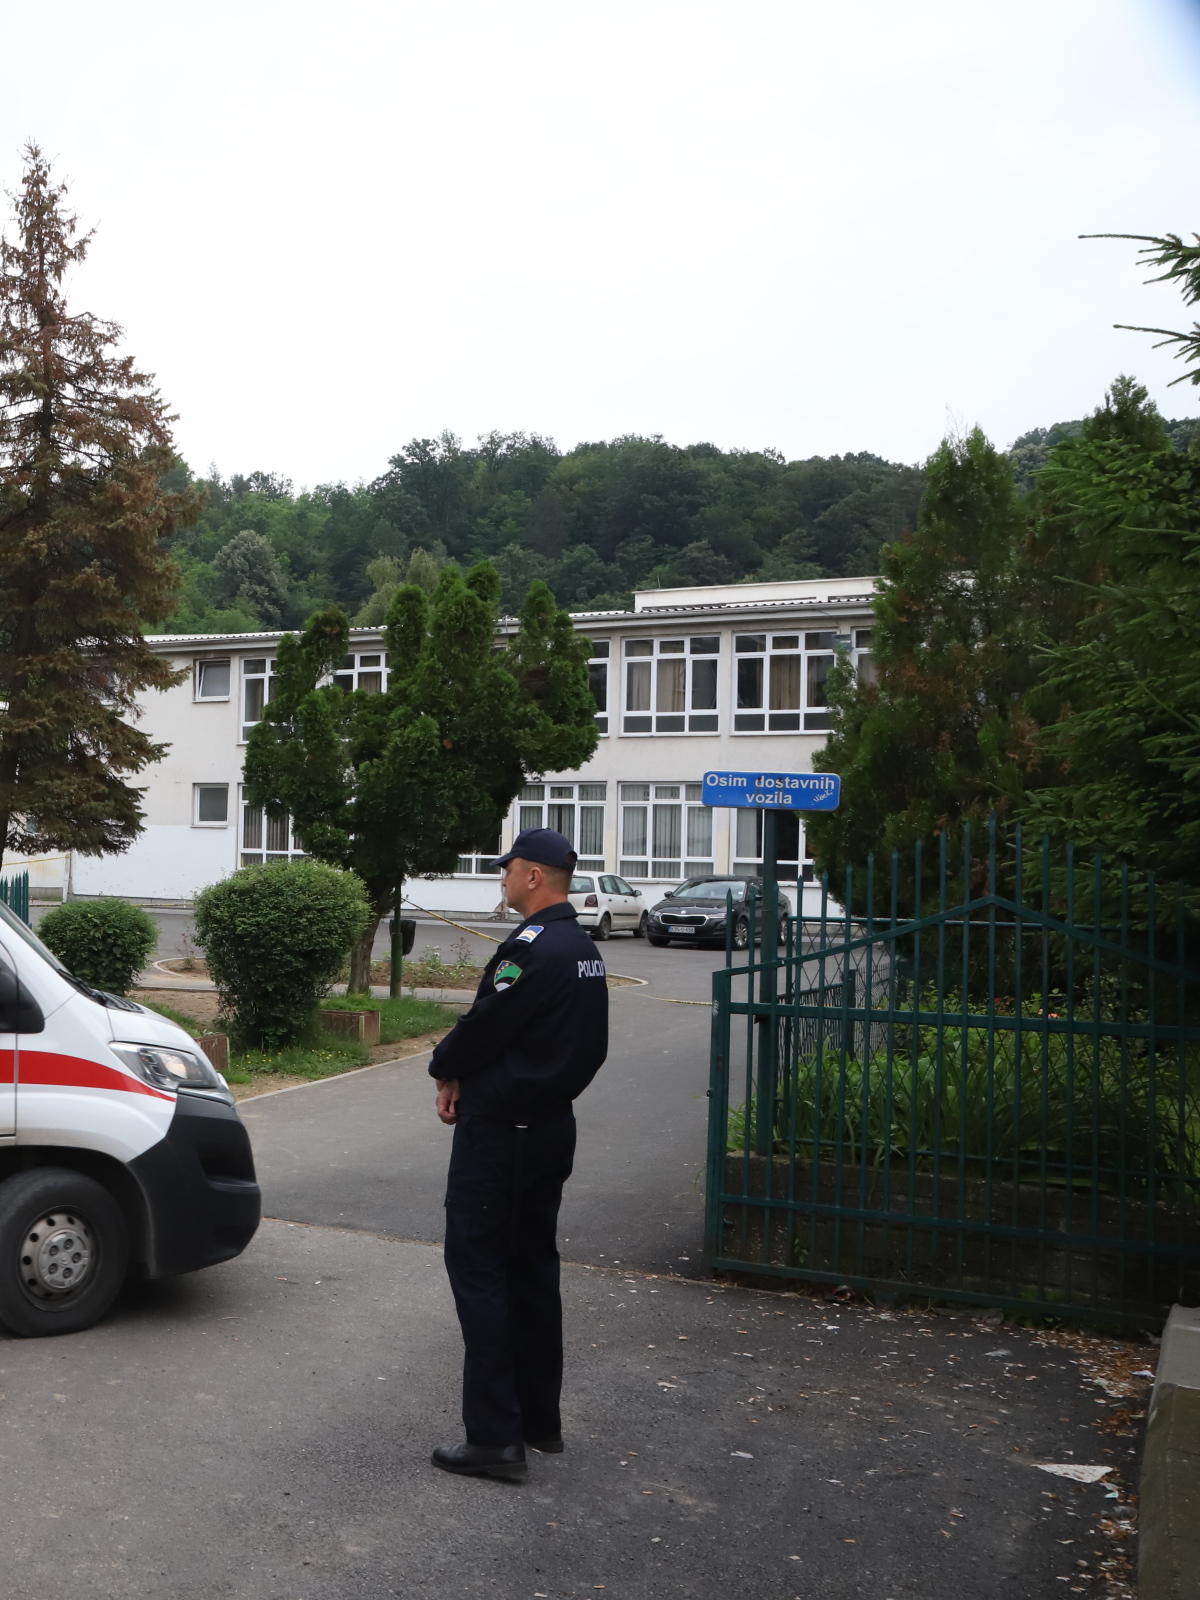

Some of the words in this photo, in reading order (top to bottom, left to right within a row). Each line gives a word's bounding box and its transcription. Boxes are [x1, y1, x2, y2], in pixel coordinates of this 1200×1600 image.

[706, 773, 747, 787] Osim
[755, 775, 835, 790] dostavnih
[746, 791, 793, 804] vozila
[577, 960, 605, 978] POLICIJ
